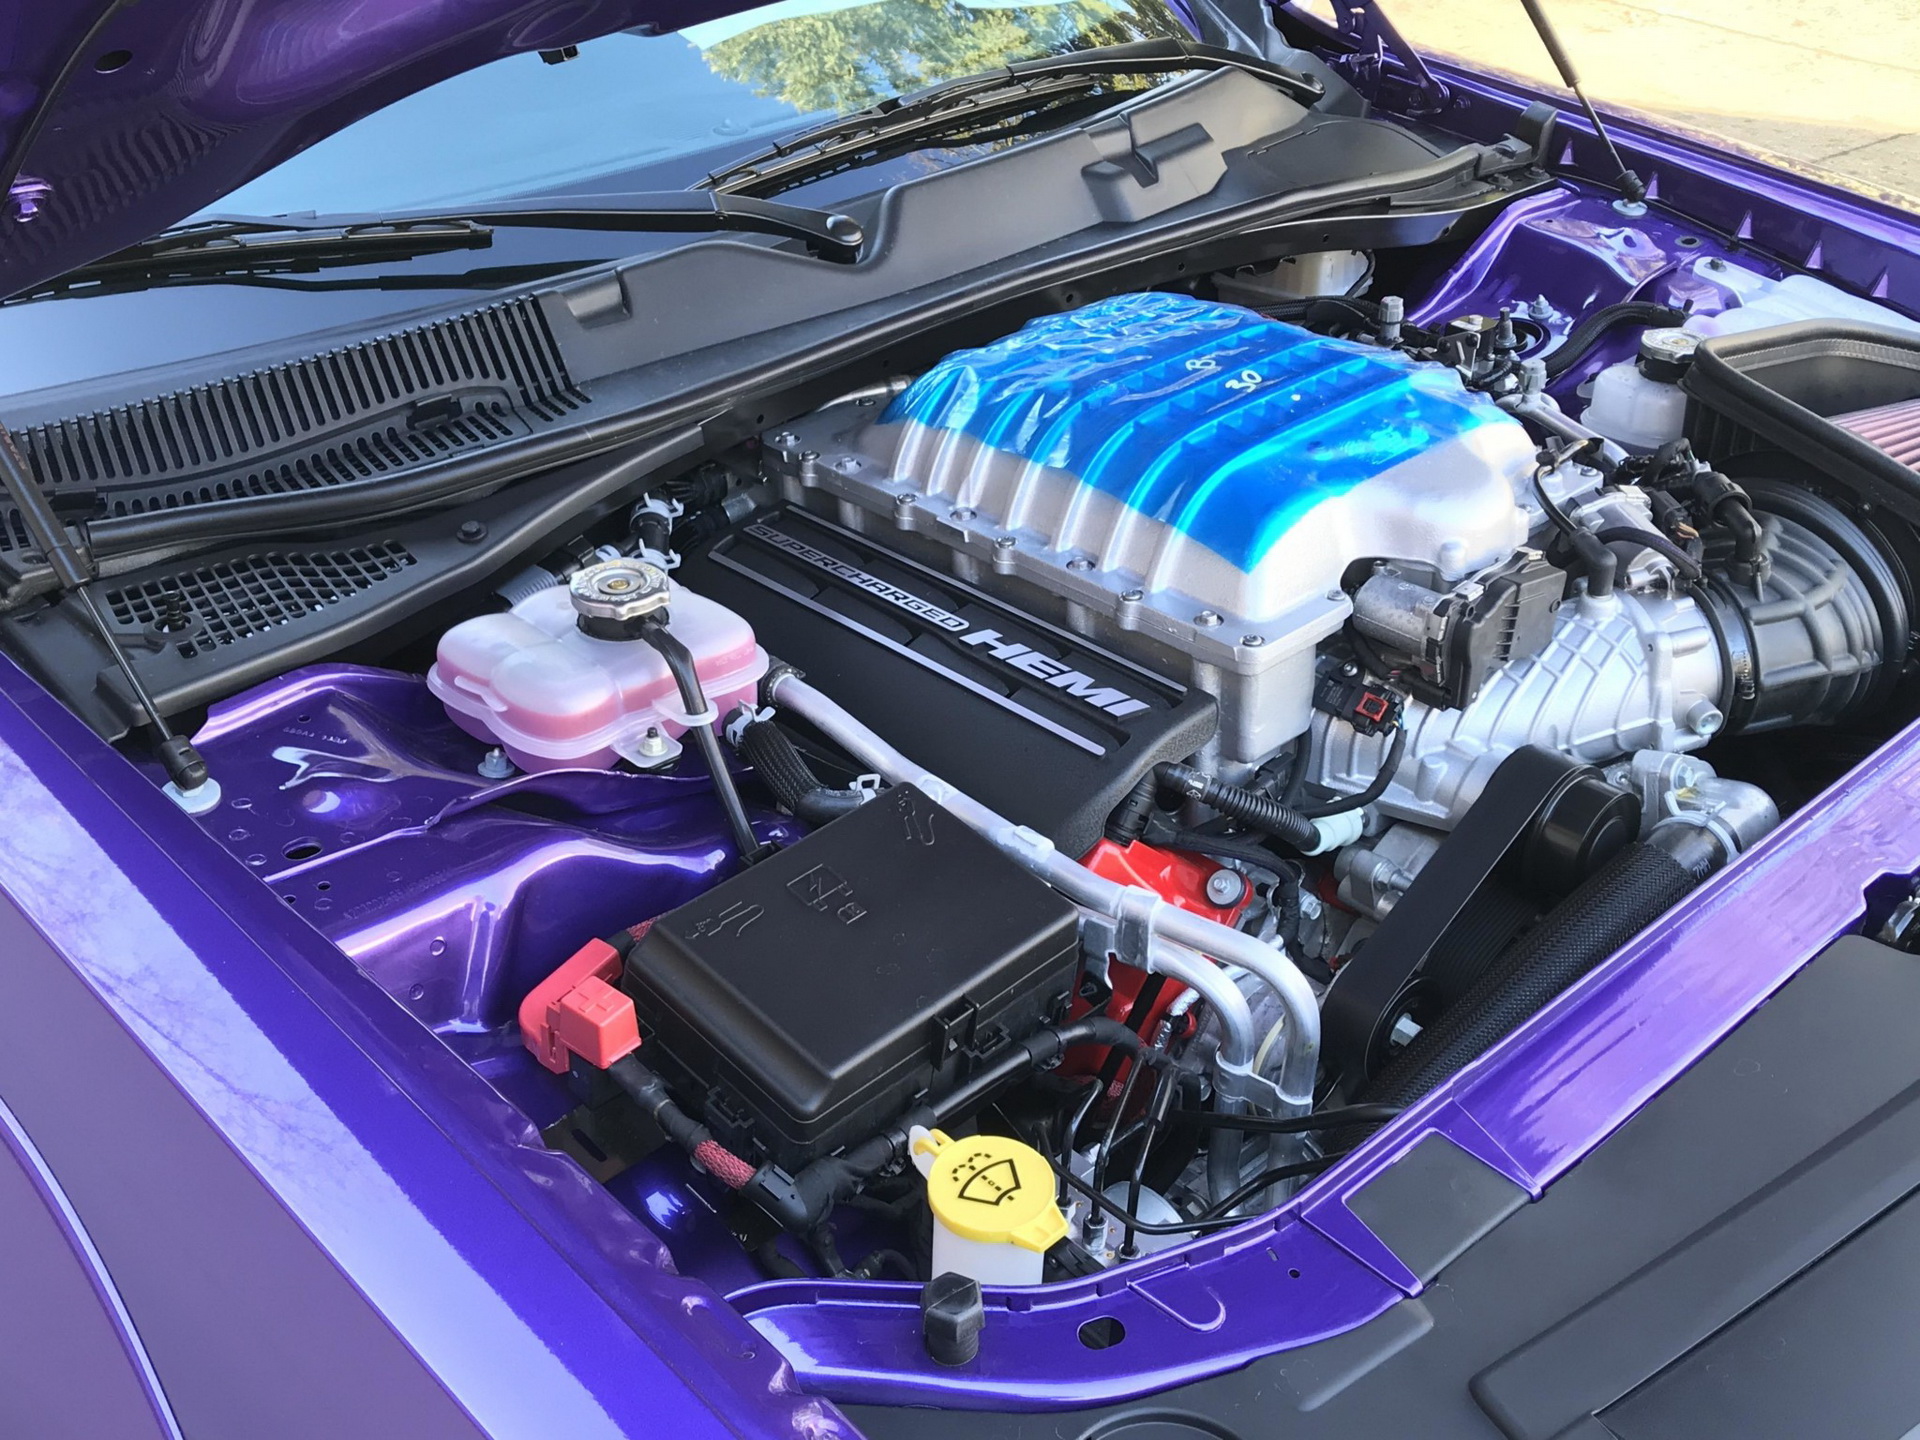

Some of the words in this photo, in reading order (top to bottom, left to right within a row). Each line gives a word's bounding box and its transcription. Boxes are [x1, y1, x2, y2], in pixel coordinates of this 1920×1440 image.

[1224, 369, 1263, 393] 30
[748, 525, 966, 630] SUPERCHARGED
[958, 628, 1151, 720] HEMI
